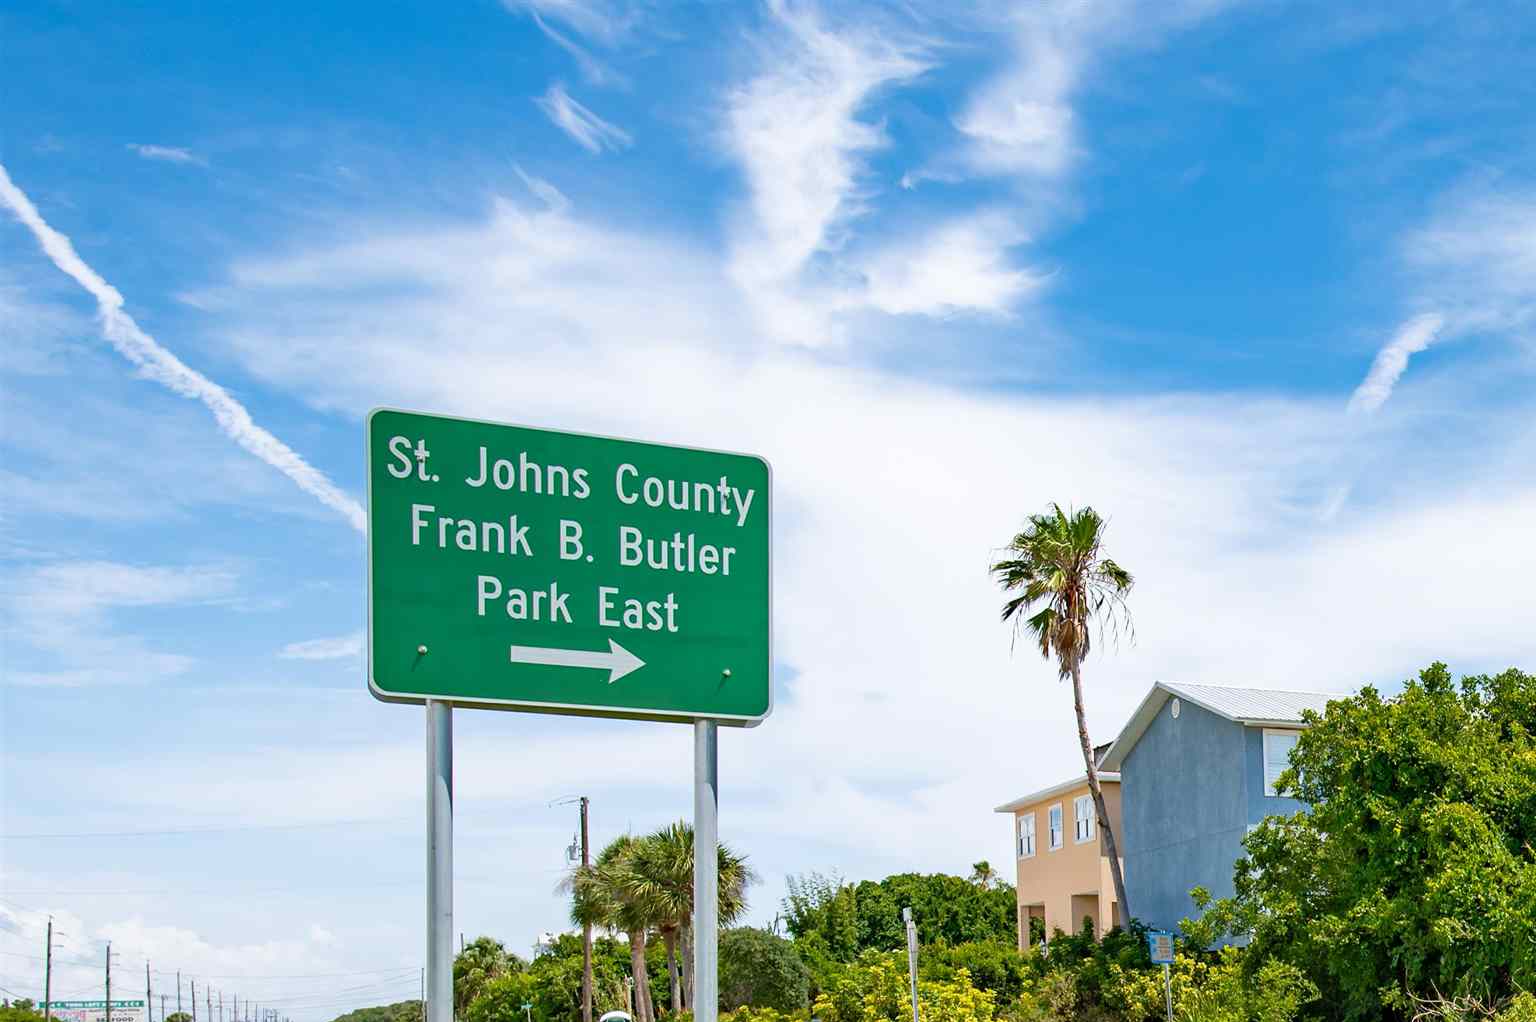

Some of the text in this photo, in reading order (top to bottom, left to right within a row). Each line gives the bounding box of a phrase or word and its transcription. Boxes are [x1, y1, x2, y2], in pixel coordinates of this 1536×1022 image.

[387, 435, 755, 527] St. Johns County
[411, 503, 737, 576] Frank B. Butler
[476, 575, 680, 634] Park East
